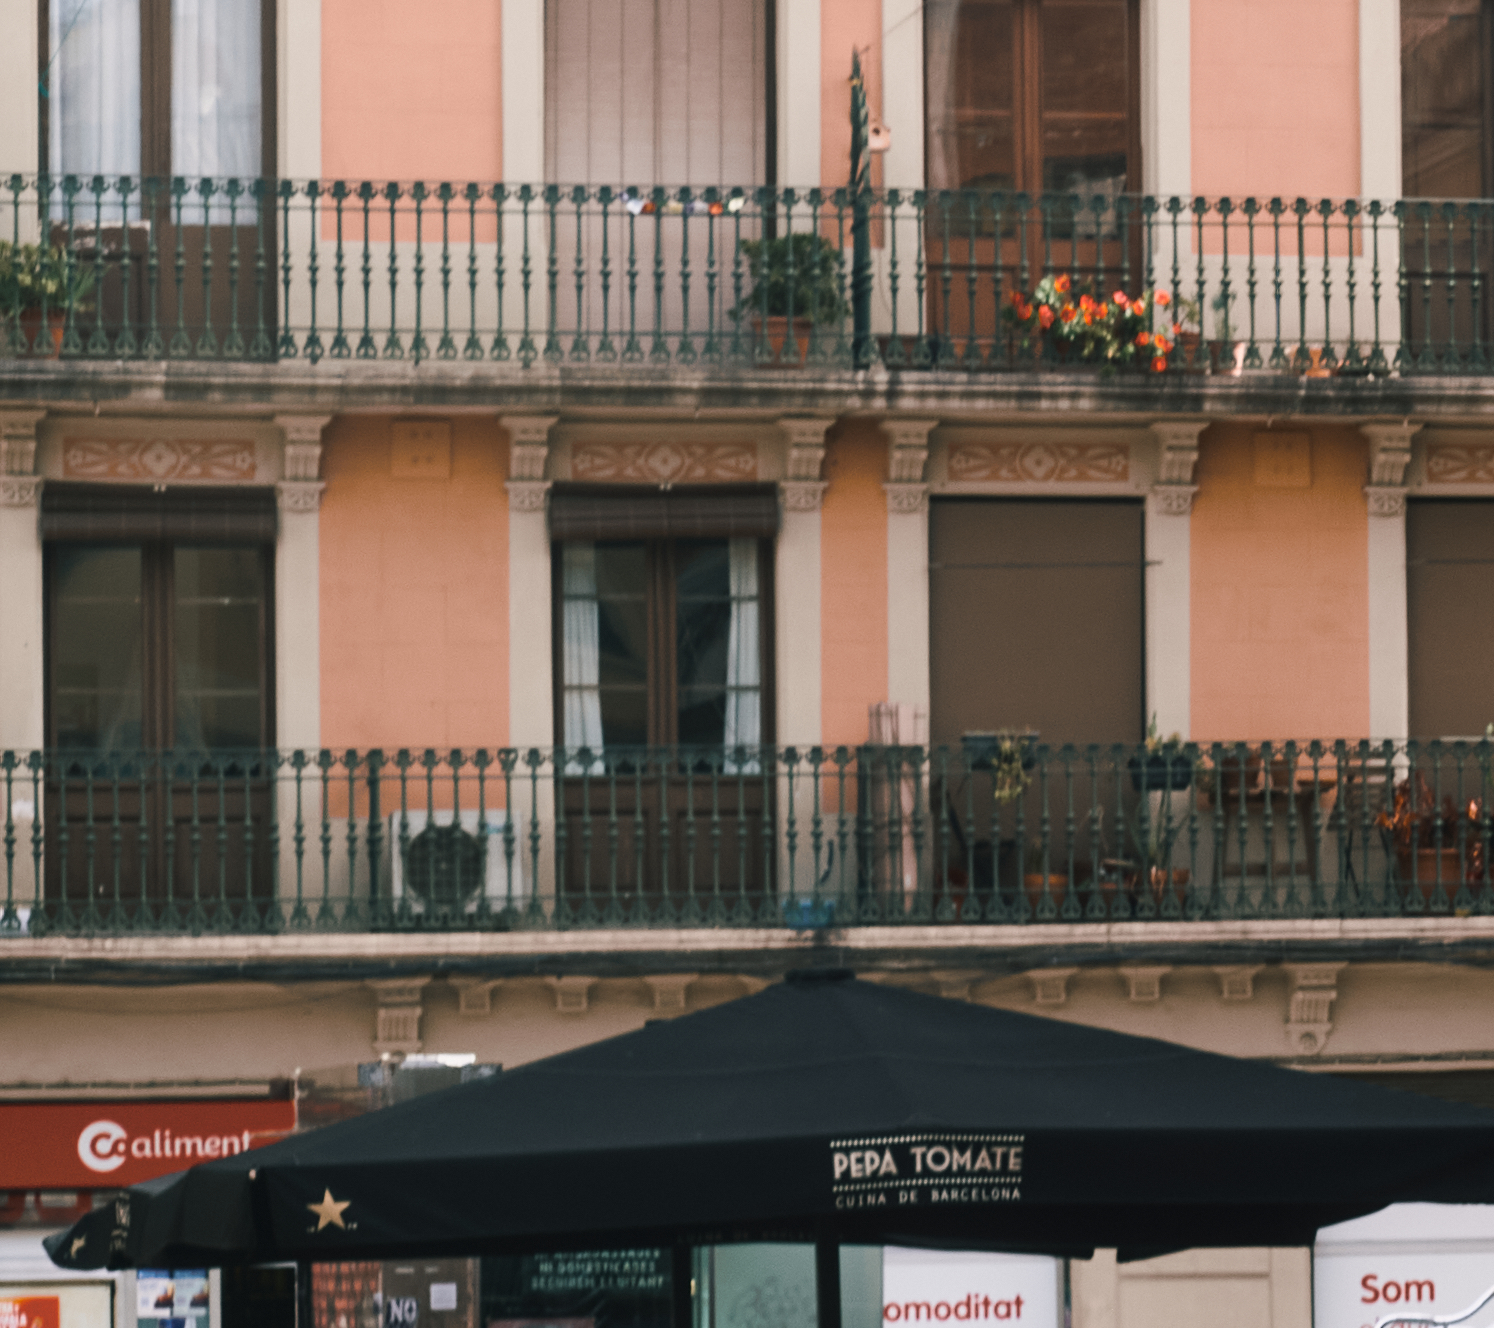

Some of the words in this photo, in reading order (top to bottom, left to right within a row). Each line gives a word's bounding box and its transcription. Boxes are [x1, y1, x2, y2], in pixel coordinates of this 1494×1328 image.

[832, 1145, 898, 1181] PEPA
[909, 1144, 1024, 1174] TOMATE
[835, 1192, 888, 1210] CUINA
[898, 1187, 919, 1205] DE
[930, 1186, 1022, 1204] BARCELONA
[1360, 1273, 1436, 1304] Som
[882, 1292, 1025, 1322] omoditat
